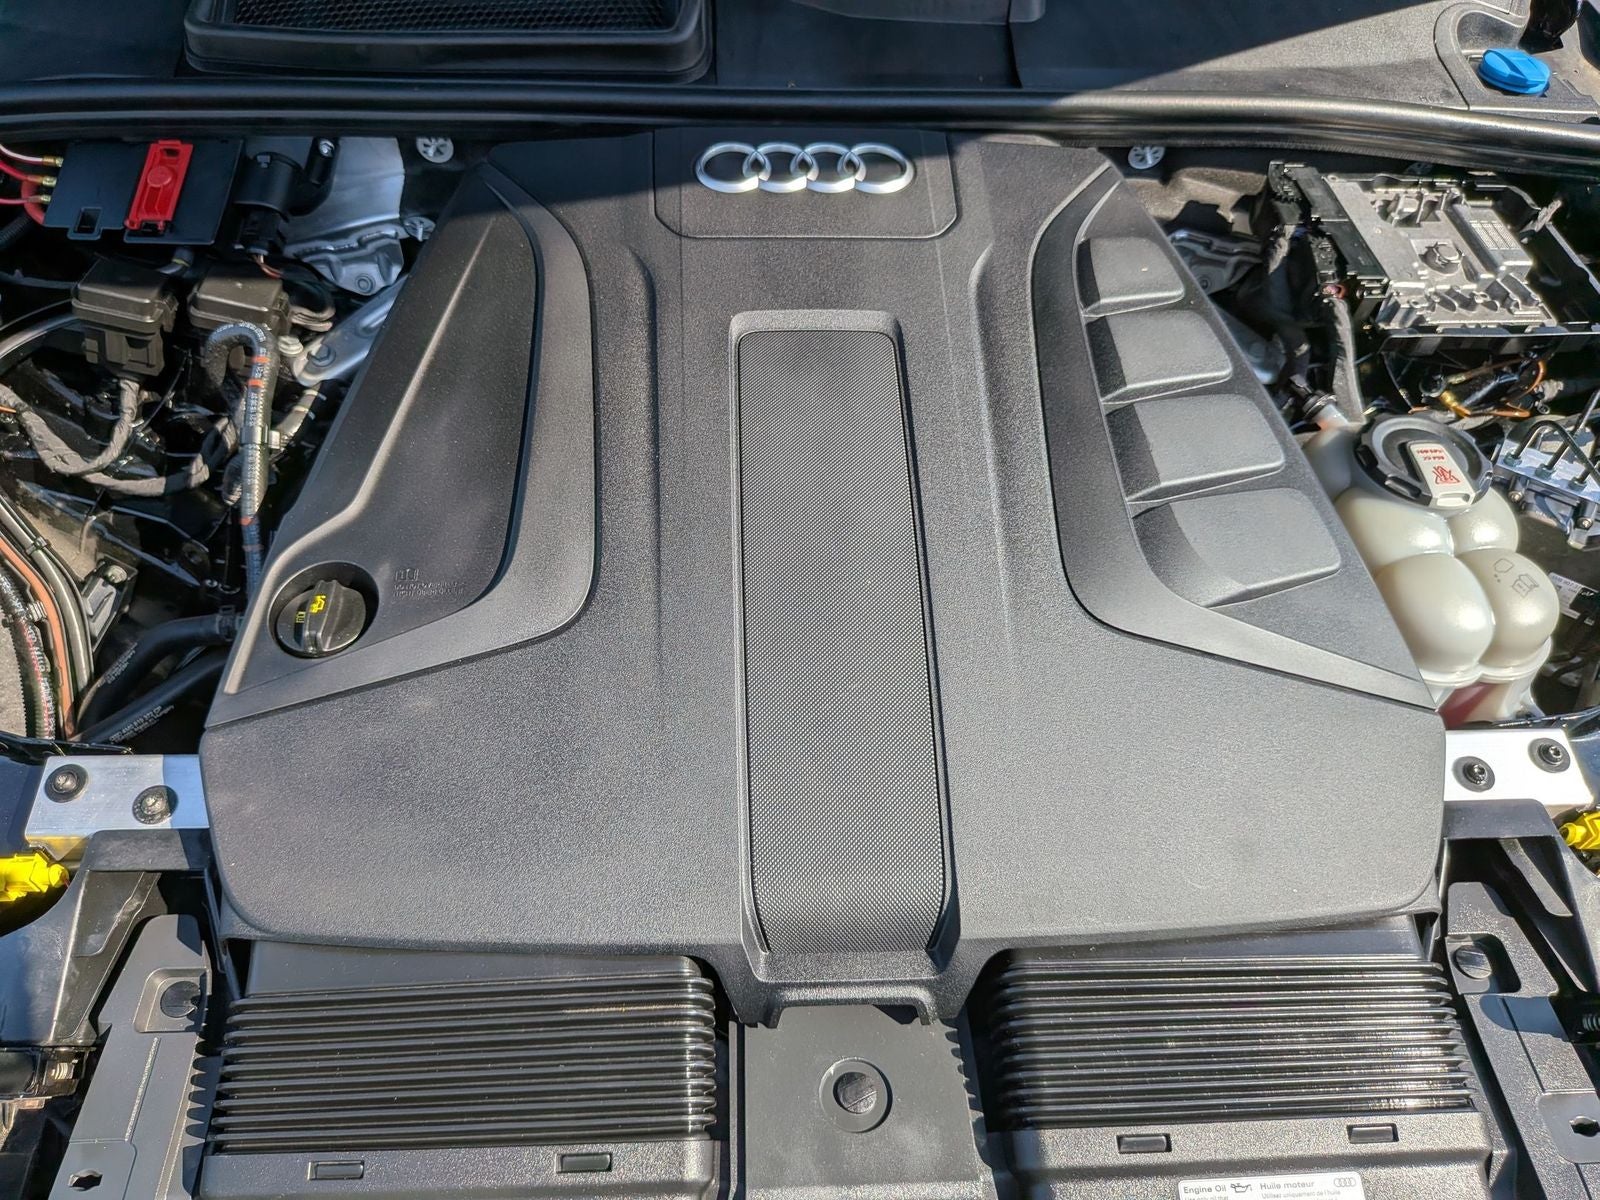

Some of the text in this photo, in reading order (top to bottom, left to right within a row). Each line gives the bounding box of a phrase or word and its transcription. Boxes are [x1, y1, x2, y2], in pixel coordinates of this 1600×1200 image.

[1183, 1184, 1227, 1195] Engine Oil
[1260, 1180, 1315, 1190] Huile moteur
